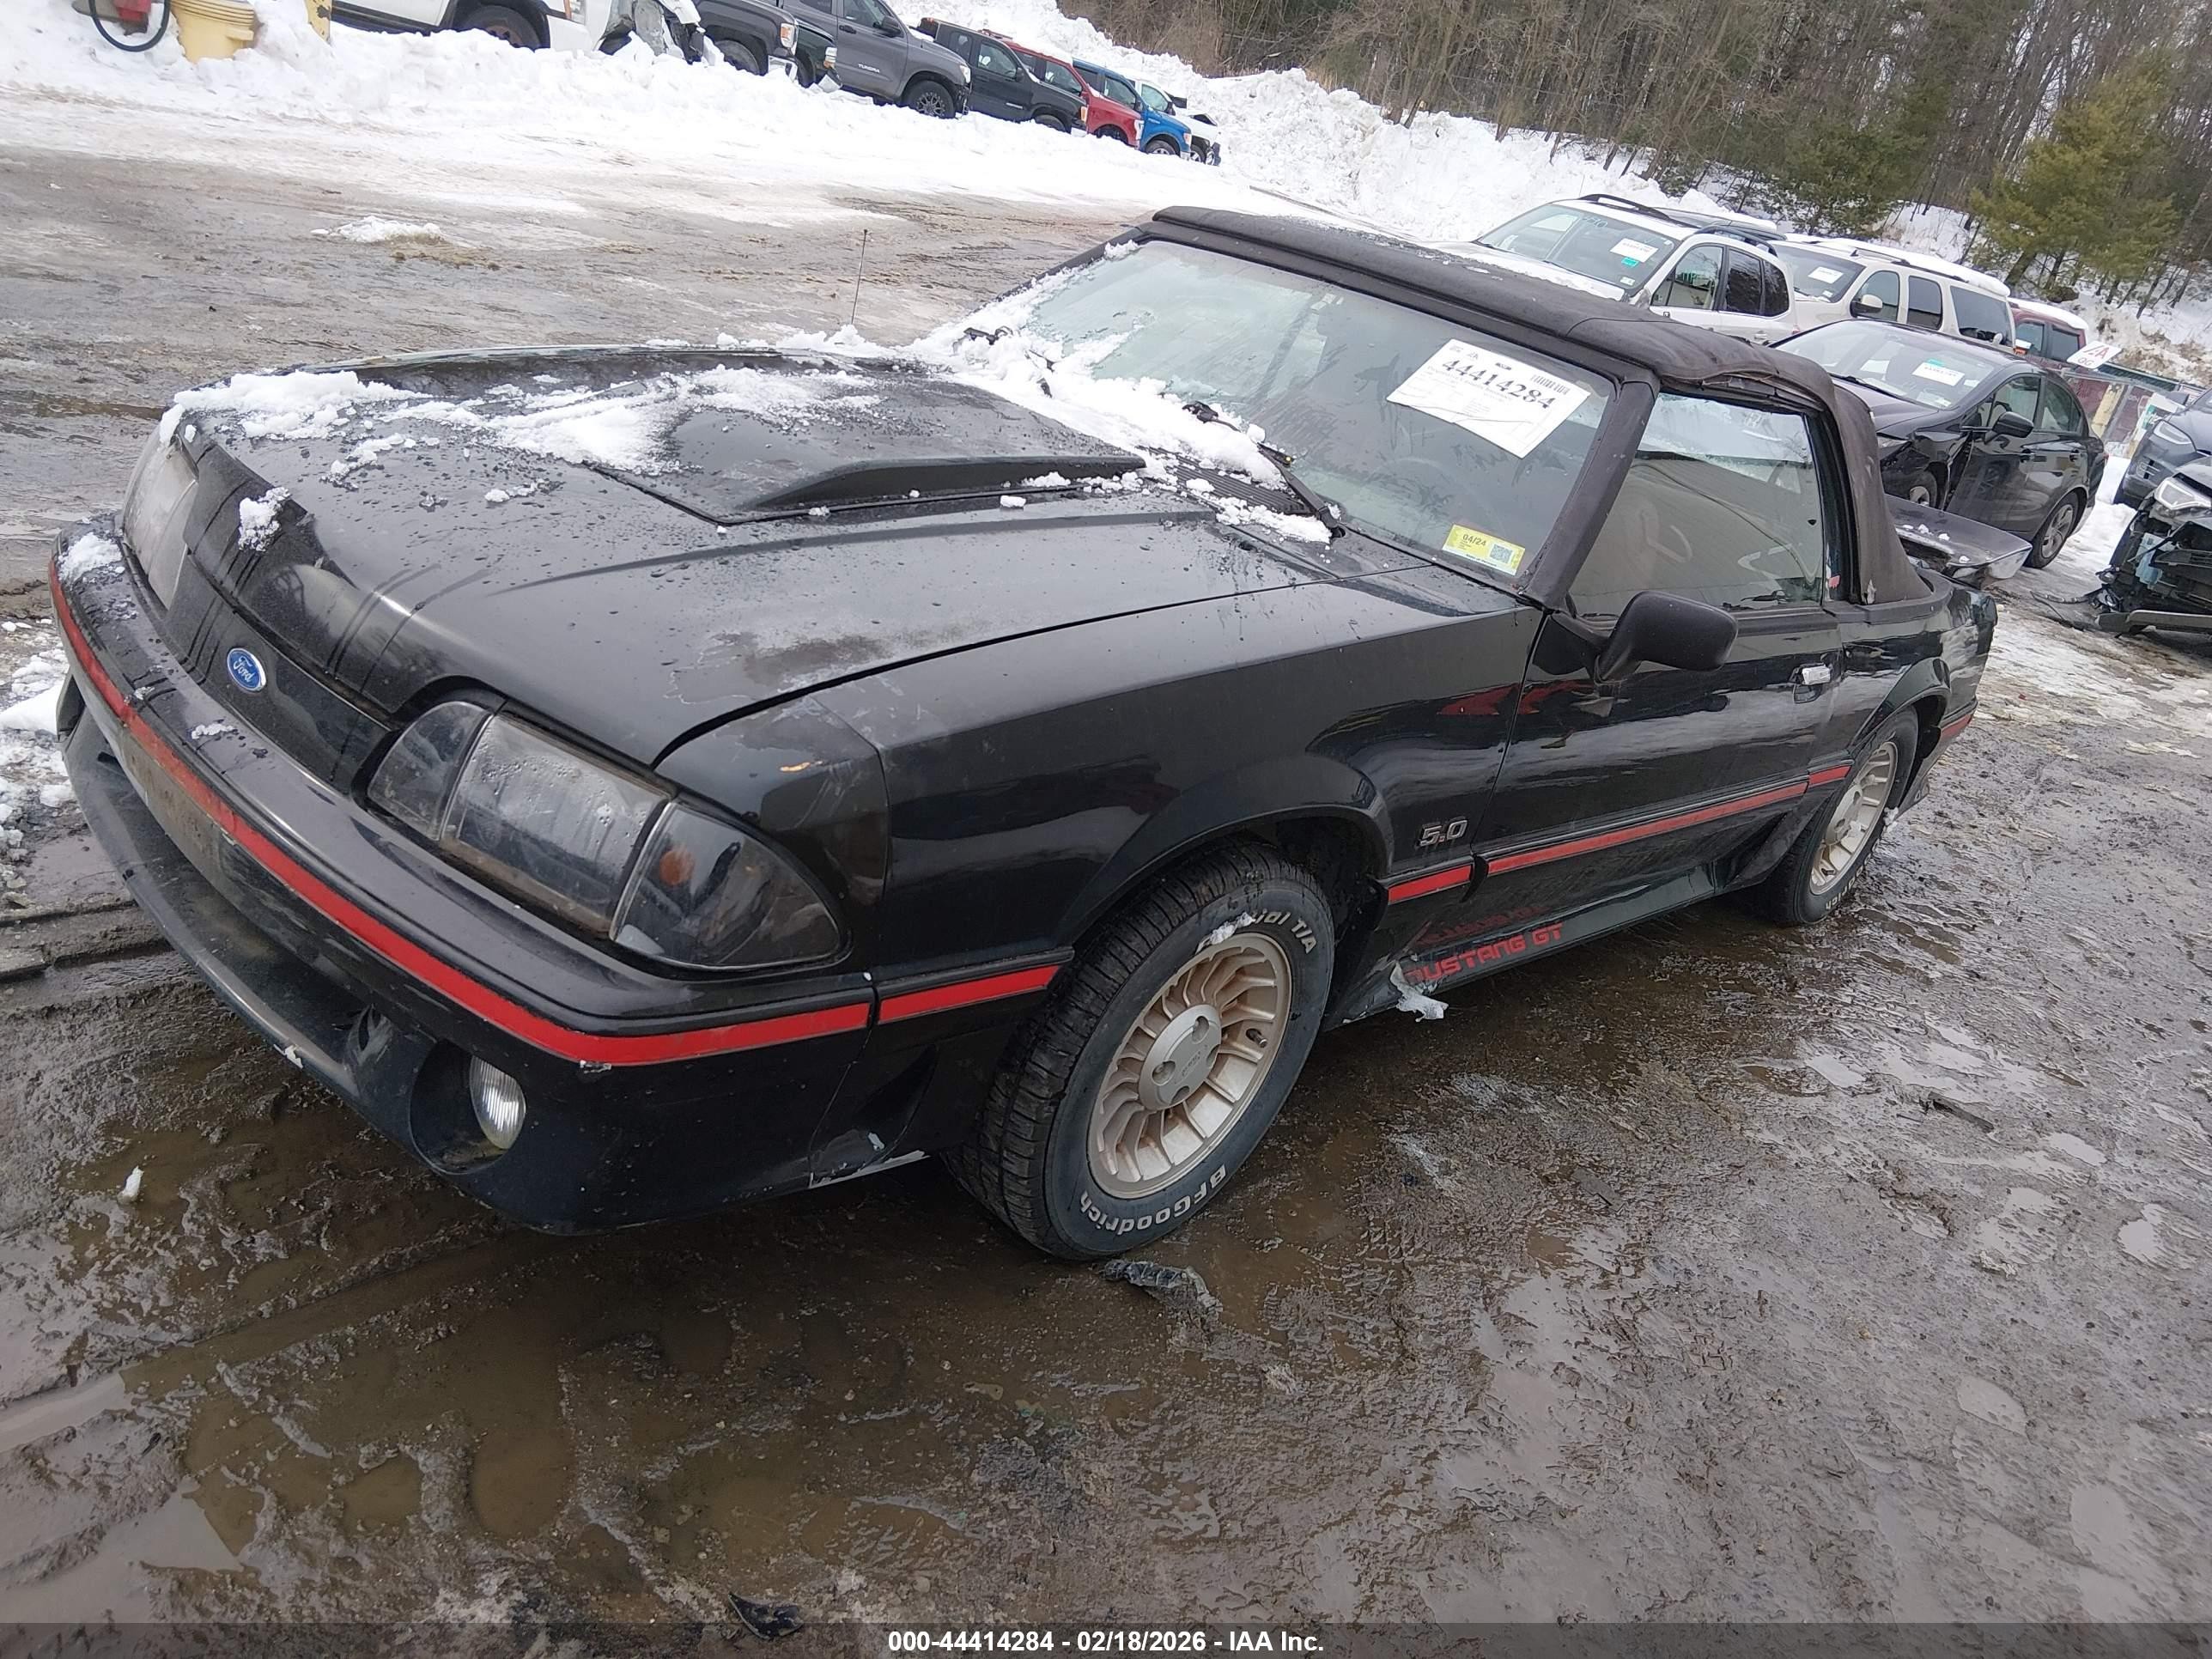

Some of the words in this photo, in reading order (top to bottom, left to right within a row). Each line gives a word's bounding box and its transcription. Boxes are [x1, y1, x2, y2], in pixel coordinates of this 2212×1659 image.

[858, 63, 880, 73] TUNDRA
[1442, 359, 1556, 410] 44414284
[1462, 533, 1487, 547] 04/24
[233, 655, 256, 683] Ford
[1419, 818, 1468, 847] 5.0
[1291, 918, 1317, 954] T/A
[1530, 921, 1565, 945] GT
[1079, 1163, 1226, 1237] BFGoodrich
